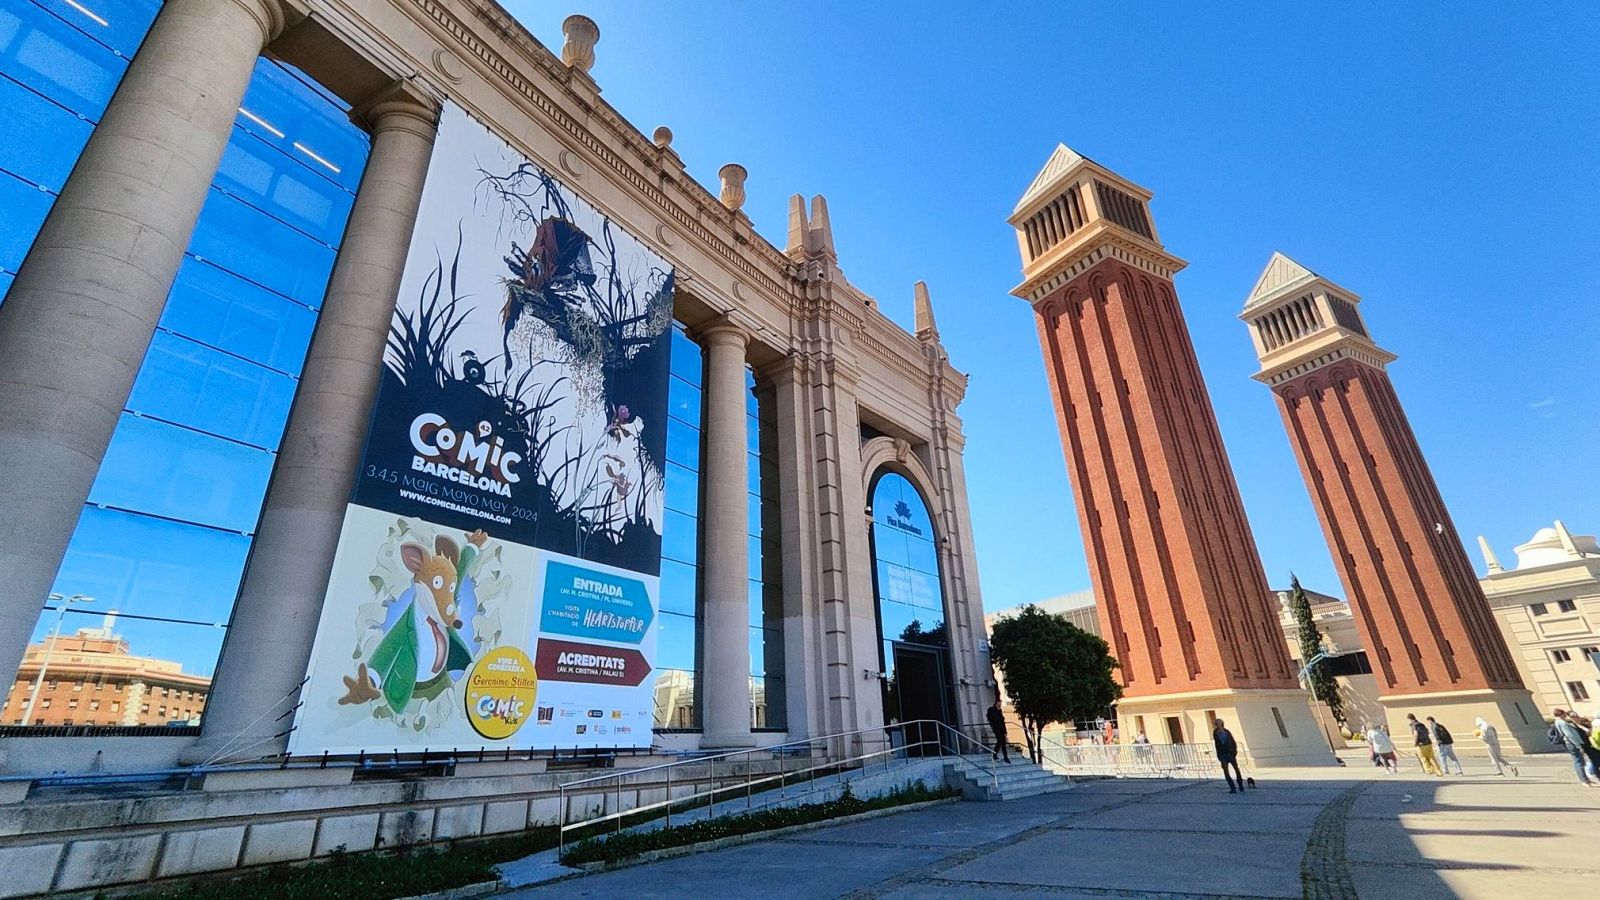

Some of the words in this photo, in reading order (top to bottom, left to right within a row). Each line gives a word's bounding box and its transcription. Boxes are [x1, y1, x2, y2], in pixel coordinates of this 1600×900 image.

[480, 424, 491, 433] 42
[411, 455, 512, 498] BARCELONA
[367, 464, 398, 484] 3.4.5
[511, 505, 538, 523] 2024
[399, 489, 512, 525] WWW.COMICBARCELONA.COM
[573, 577, 623, 598] ENTRADA
[578, 591, 600, 601] CRISTINA
[557, 652, 625, 670] ACREDITATS
[473, 674, 509, 686] Geronimo
[511, 676, 535, 687] Stilton
[575, 668, 598, 676] CRISTINA
